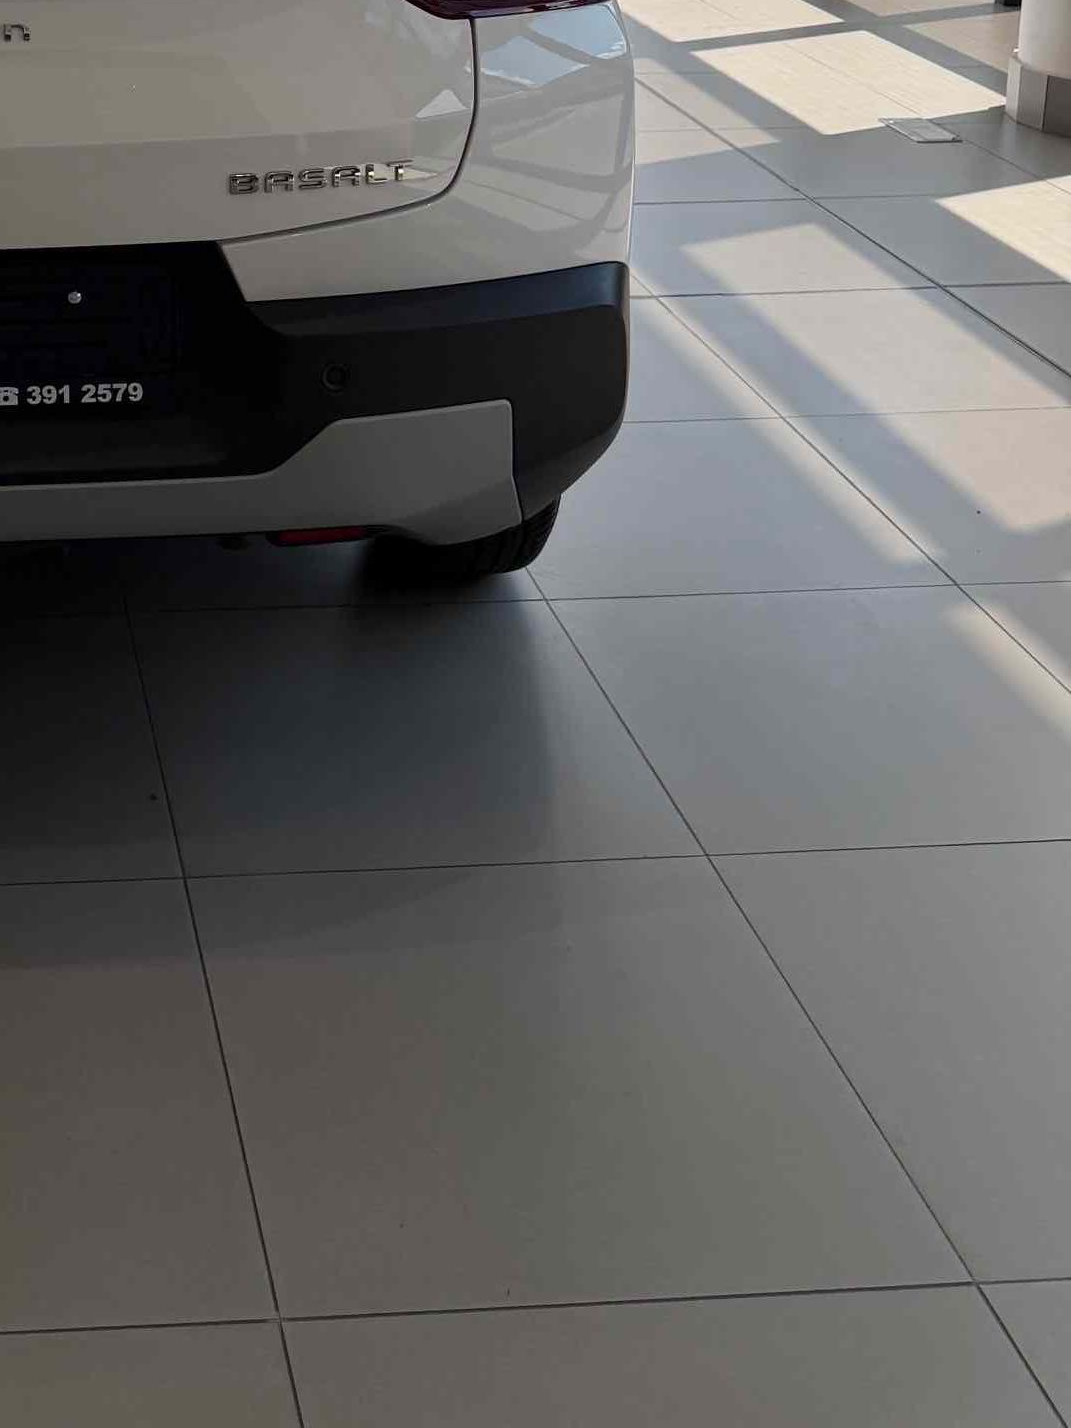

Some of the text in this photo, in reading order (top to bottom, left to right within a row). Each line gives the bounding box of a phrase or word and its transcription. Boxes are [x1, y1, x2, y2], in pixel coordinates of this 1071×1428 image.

[228, 159, 414, 195] BASALT
[26, 384, 70, 405] 391
[80, 382, 144, 404] 2579
